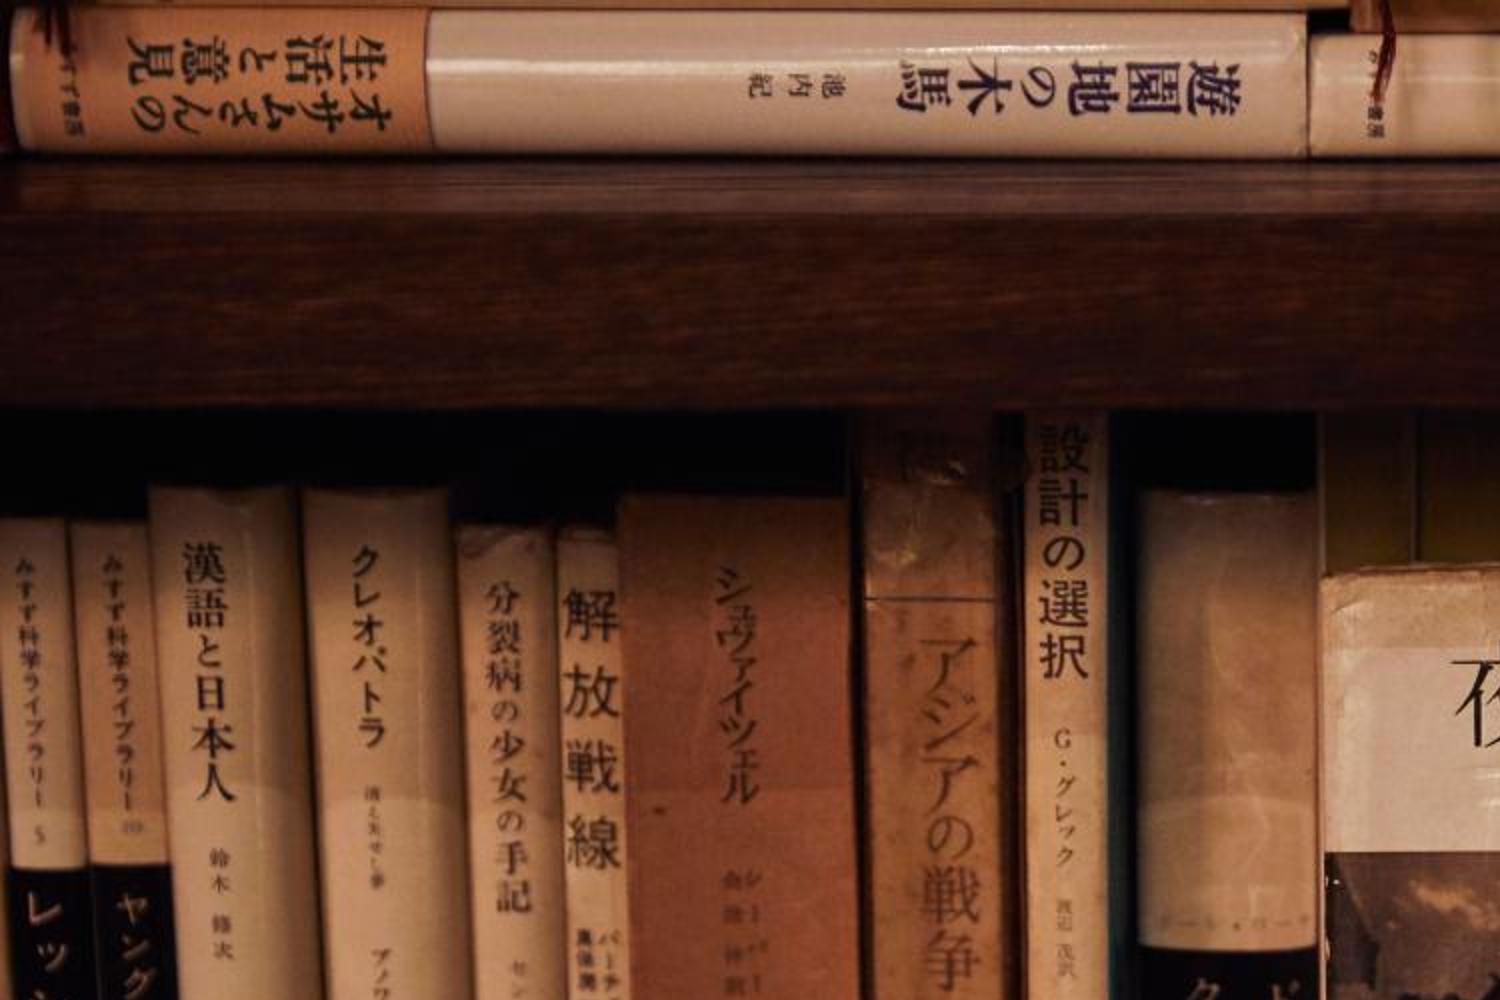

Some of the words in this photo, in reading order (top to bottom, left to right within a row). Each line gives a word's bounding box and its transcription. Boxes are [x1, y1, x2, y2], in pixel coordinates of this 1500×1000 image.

[126, 35, 388, 85] 生活と意見
[131, 91, 392, 134] オサムさんの
[748, 71, 847, 98] 池内紀
[896, 56, 1242, 117] 遊園地の木馬
[350, 545, 387, 749] クレオパトラ
[1038, 424, 1090, 681] 設計の選択
[181, 542, 237, 803] 漢語と日本人
[484, 579, 533, 913] 分裂病の少女の手記
[563, 587, 622, 872] 解放戦線
[715, 565, 760, 804] シュヴァイツェル
[920, 635, 983, 993] アジアの戦争
